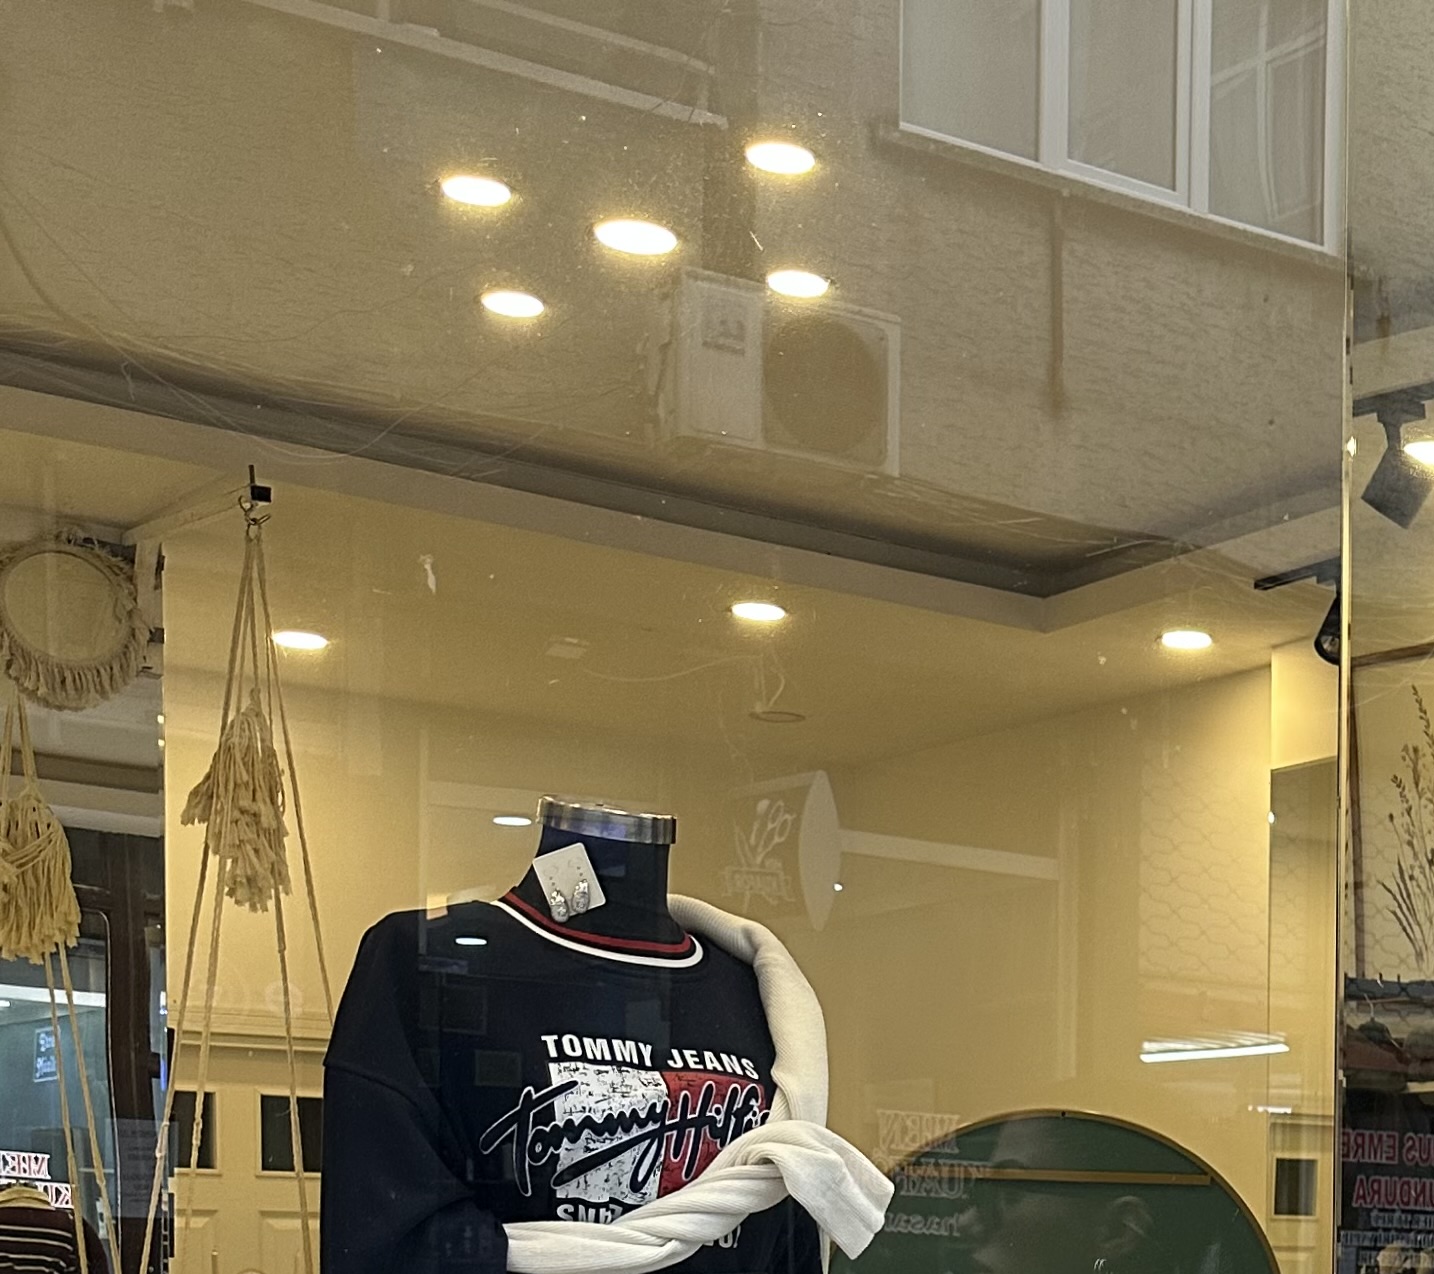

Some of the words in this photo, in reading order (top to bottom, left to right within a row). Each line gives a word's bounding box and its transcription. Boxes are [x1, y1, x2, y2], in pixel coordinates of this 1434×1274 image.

[541, 1034, 653, 1068] TOMMY
[667, 1048, 760, 1080] JEANS
[479, 1080, 671, 1197] Tommy
